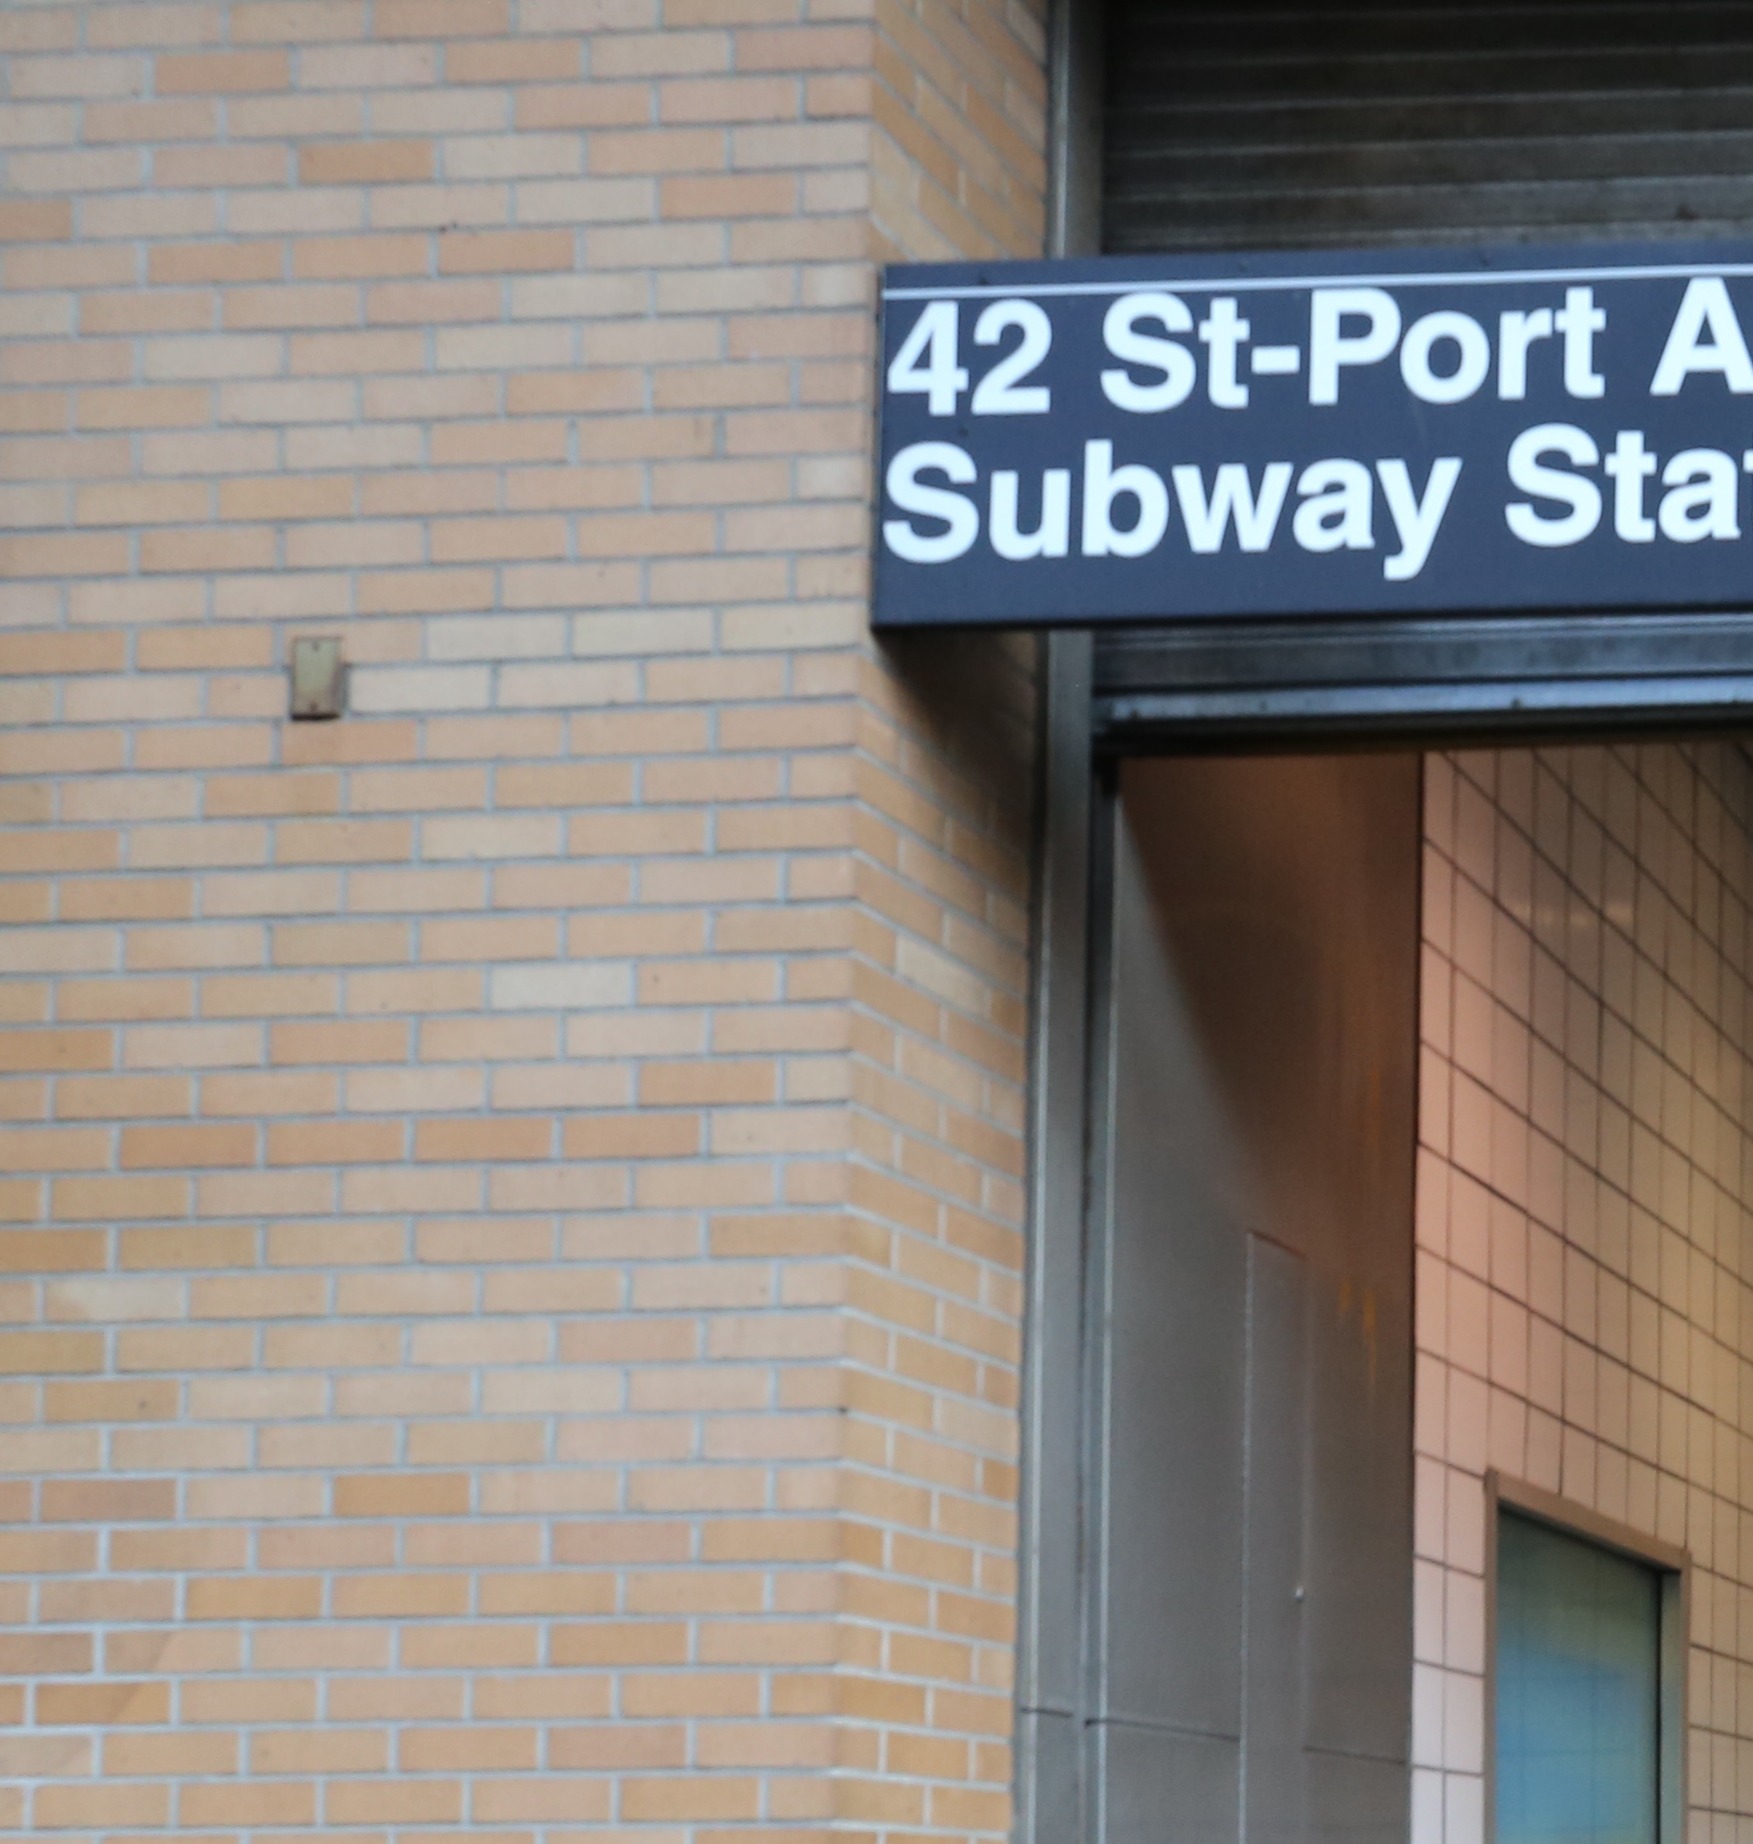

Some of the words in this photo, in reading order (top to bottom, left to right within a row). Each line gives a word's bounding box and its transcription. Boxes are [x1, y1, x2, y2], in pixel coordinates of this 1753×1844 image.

[888, 300, 1051, 416] 42
[1101, 287, 1605, 413] St-Port
[882, 438, 1462, 582] Subway
